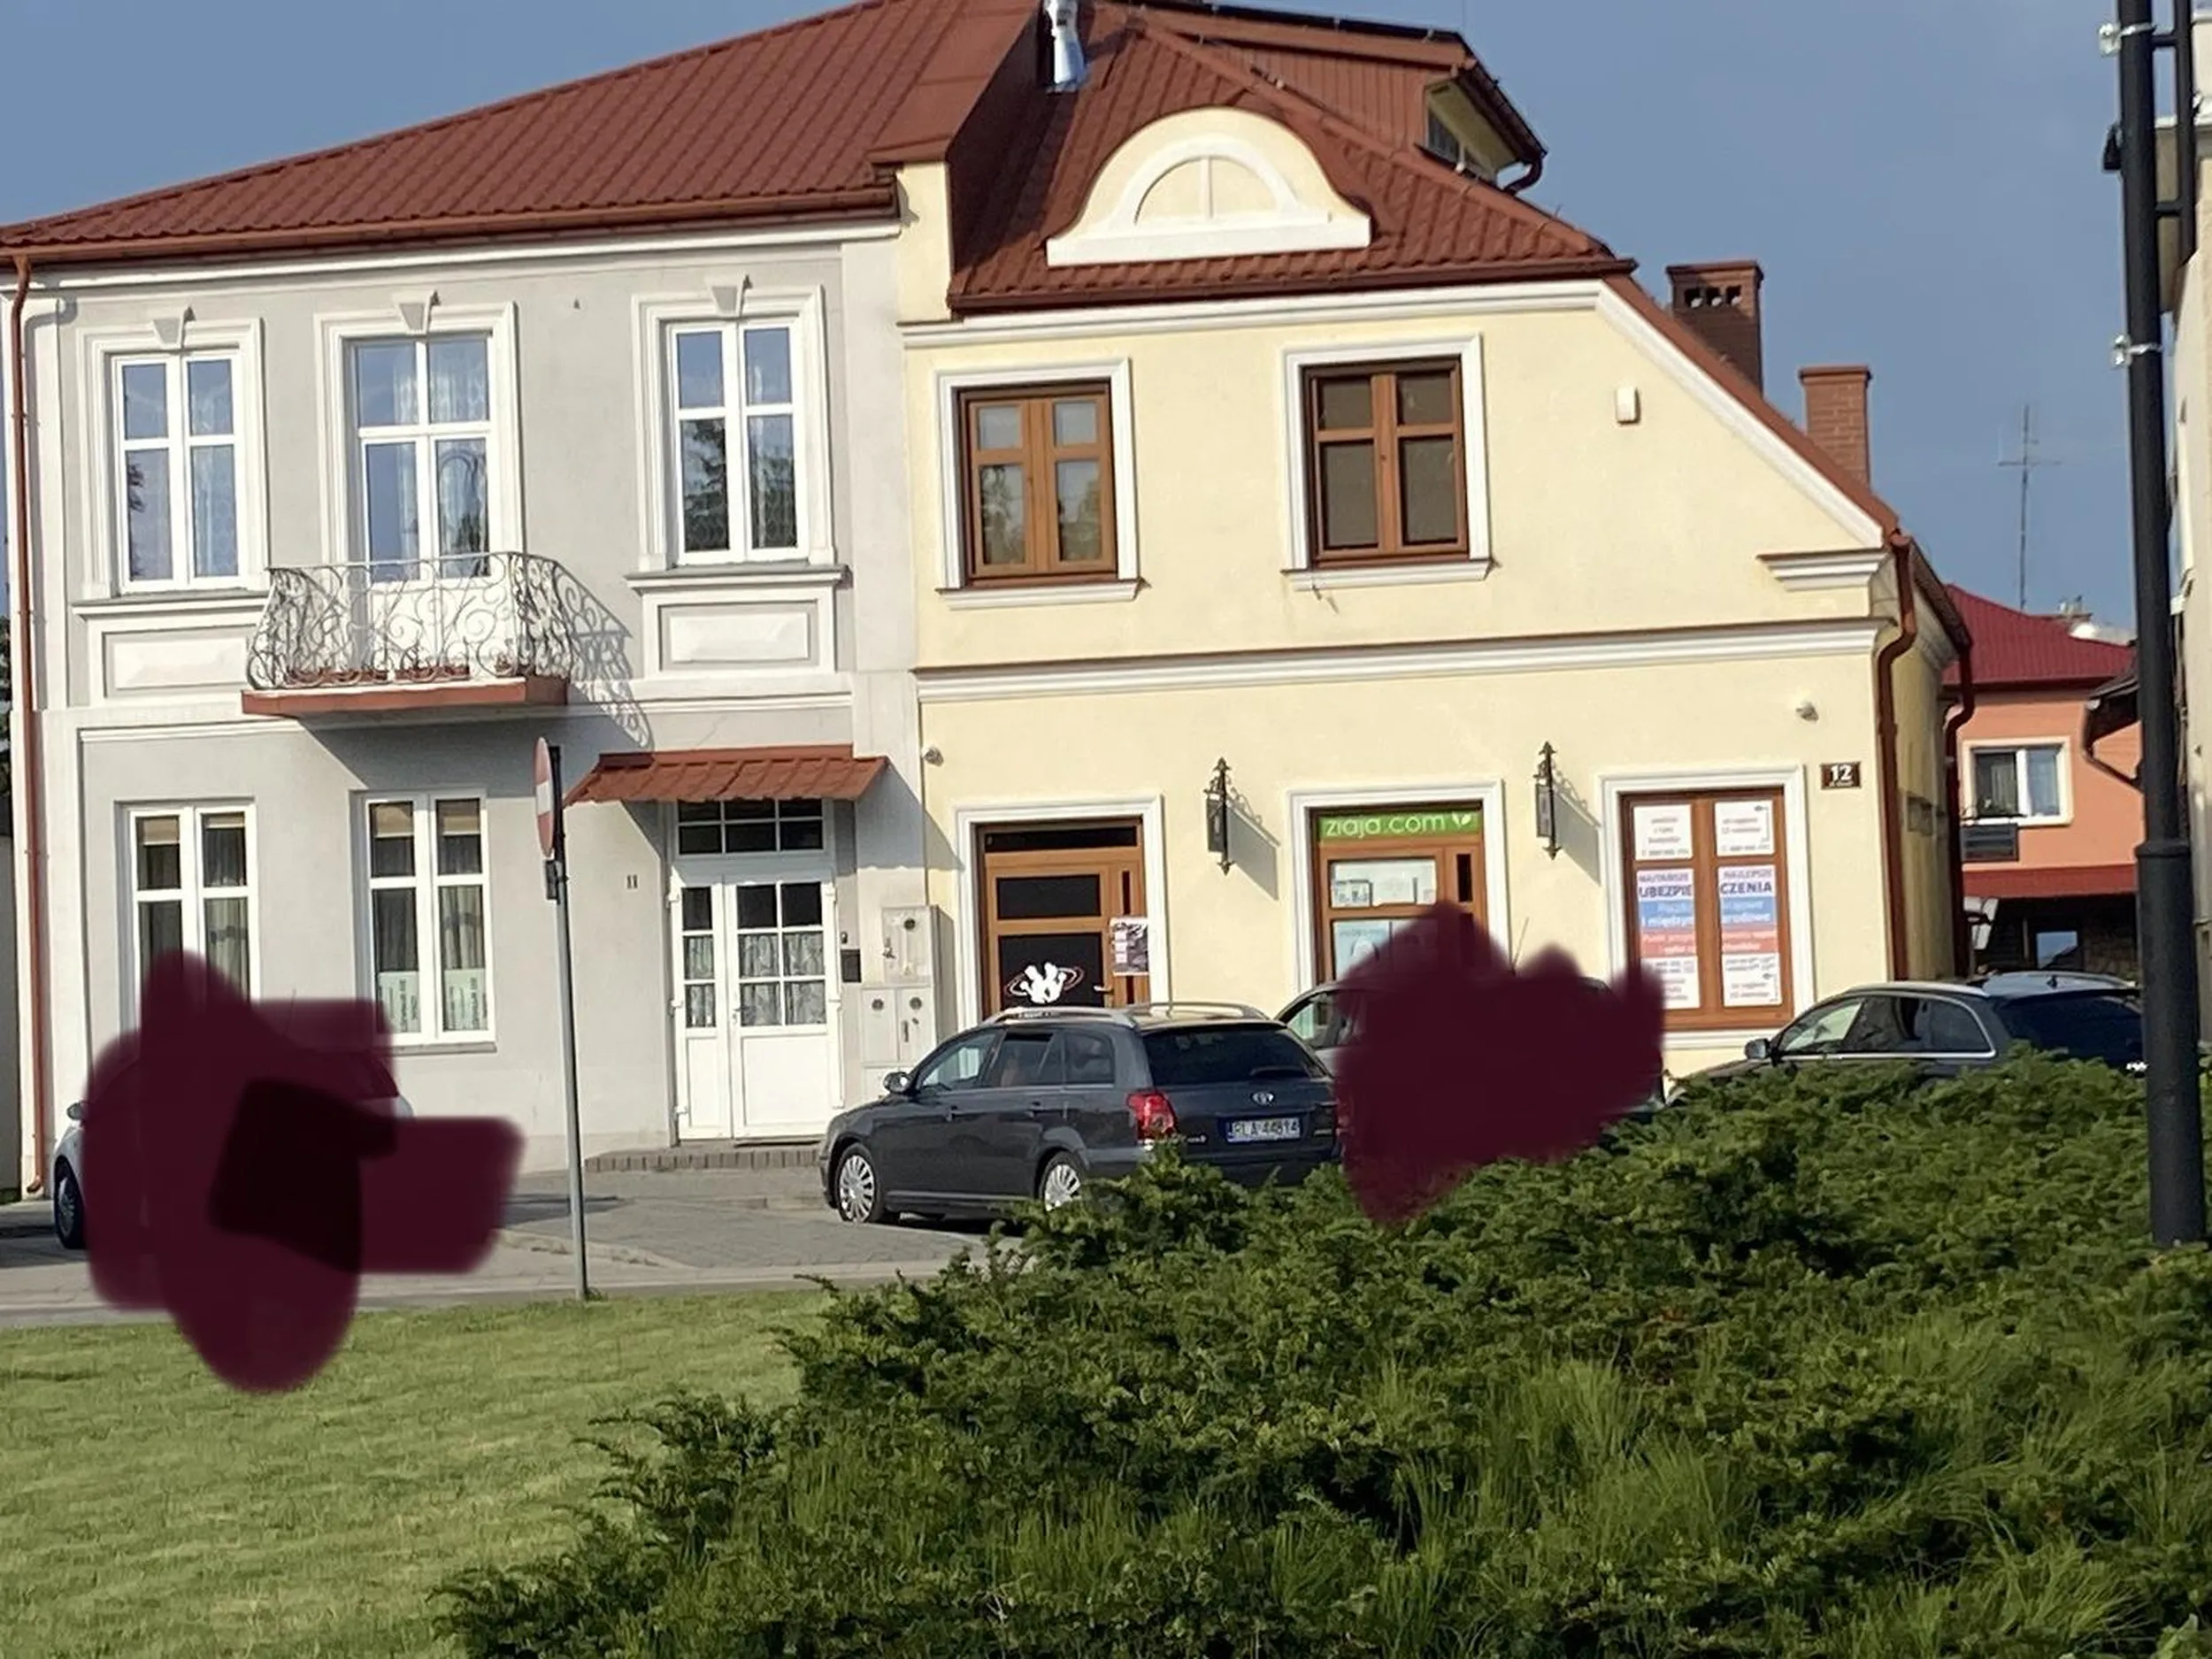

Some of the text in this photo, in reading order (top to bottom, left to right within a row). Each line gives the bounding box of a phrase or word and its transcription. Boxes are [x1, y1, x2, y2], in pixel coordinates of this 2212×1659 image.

[1831, 764, 1852, 781] 12
[1639, 881, 1773, 898] UBEZPIE CZENIA
